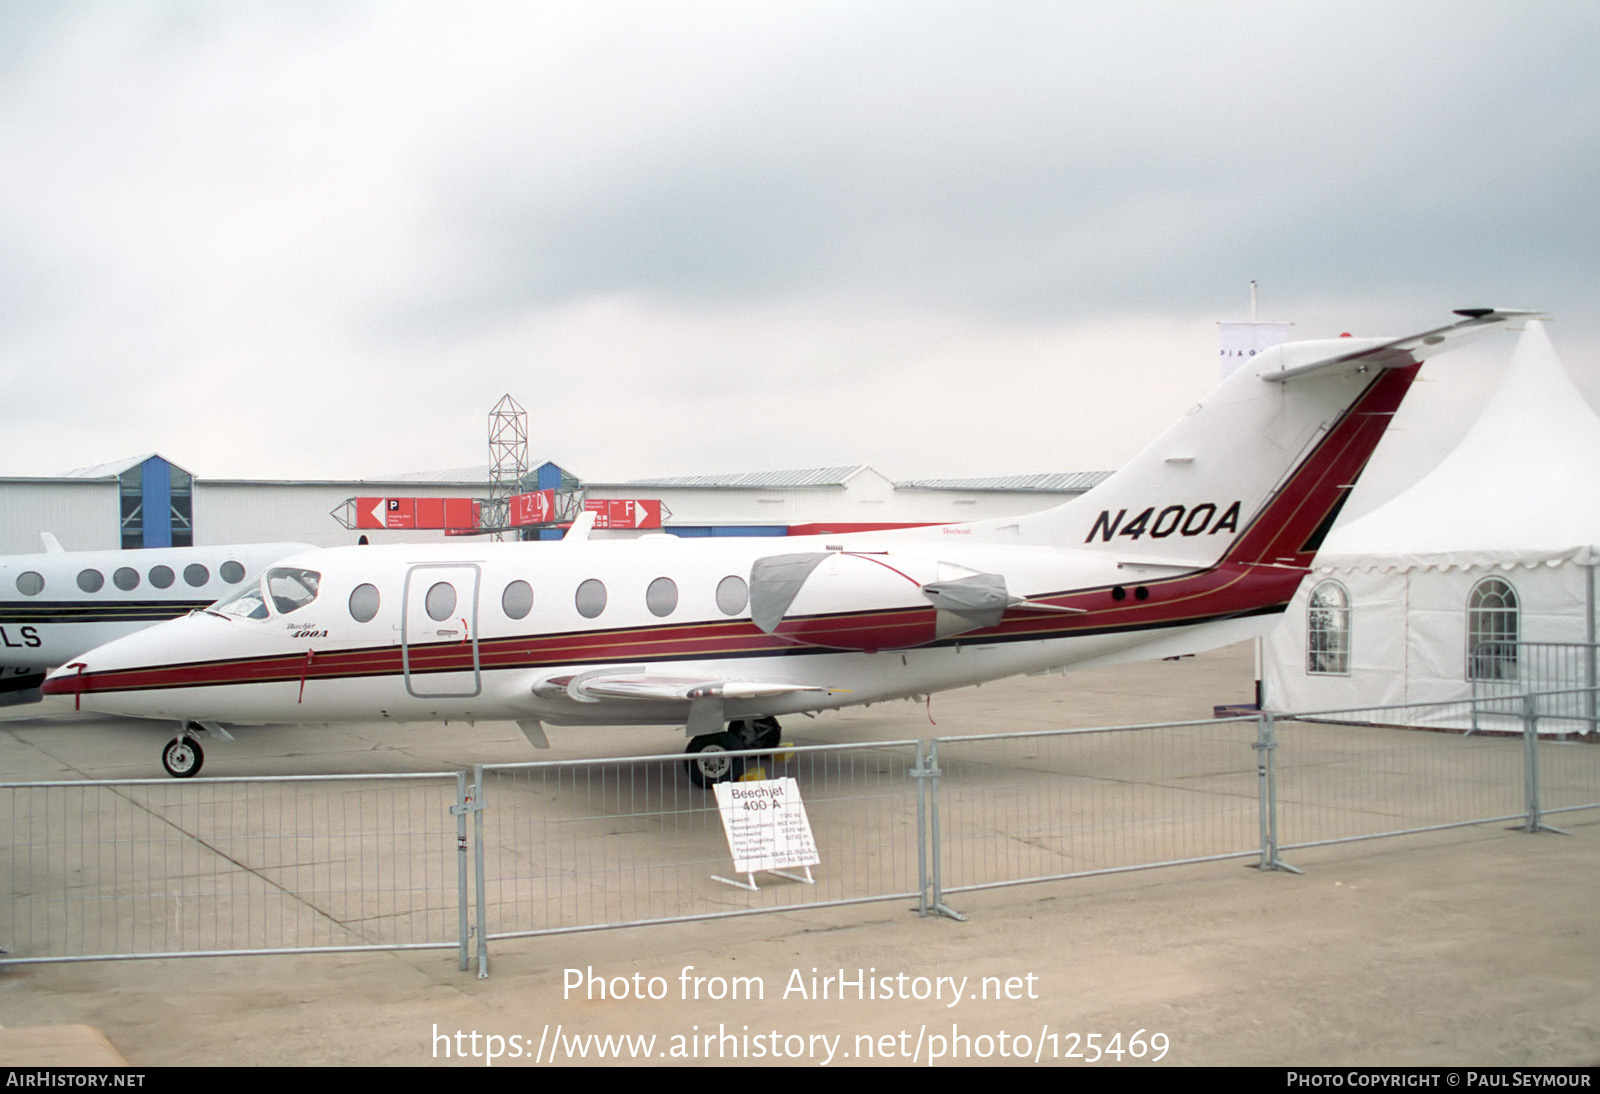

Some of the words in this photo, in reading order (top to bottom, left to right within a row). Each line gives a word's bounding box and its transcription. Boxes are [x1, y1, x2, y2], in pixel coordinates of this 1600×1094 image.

[1220, 349, 1263, 357] PIAG
[625, 501, 634, 517] F
[1084, 500, 1242, 544] N400A
[0, 626, 42, 648] LS
[290, 629, 329, 638] 400A
[731, 786, 784, 799] Beechjet
[743, 800, 767, 811] 400
[772, 799, 781, 809] A
